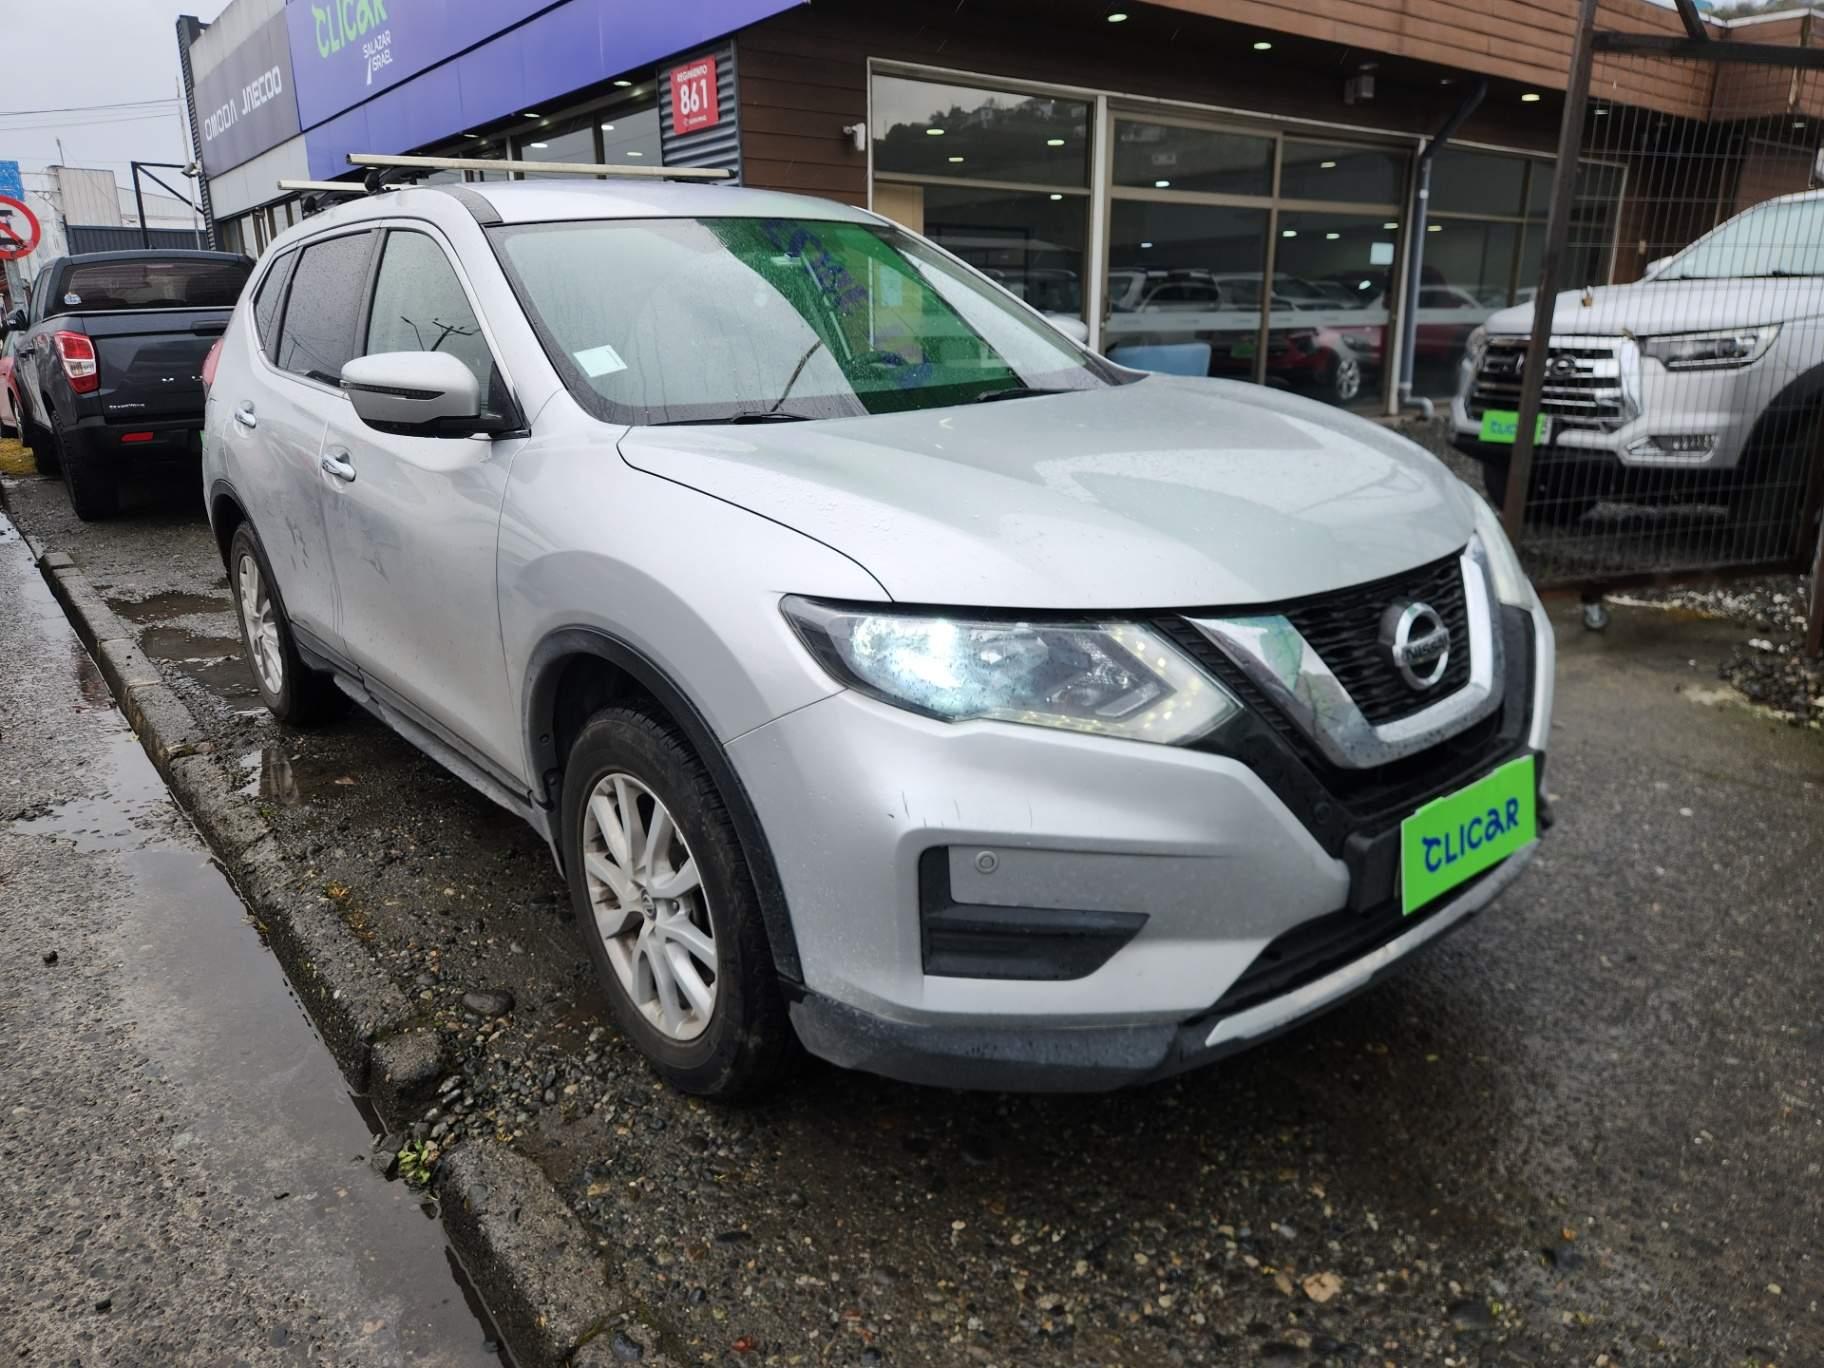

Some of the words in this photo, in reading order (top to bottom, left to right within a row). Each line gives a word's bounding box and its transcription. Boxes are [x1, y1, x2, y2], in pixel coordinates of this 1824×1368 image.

[362, 29, 392, 59] SALAZAR
[204, 98, 239, 141] OMODA
[241, 64, 283, 115] JAECOO
[680, 78, 708, 116] 861
